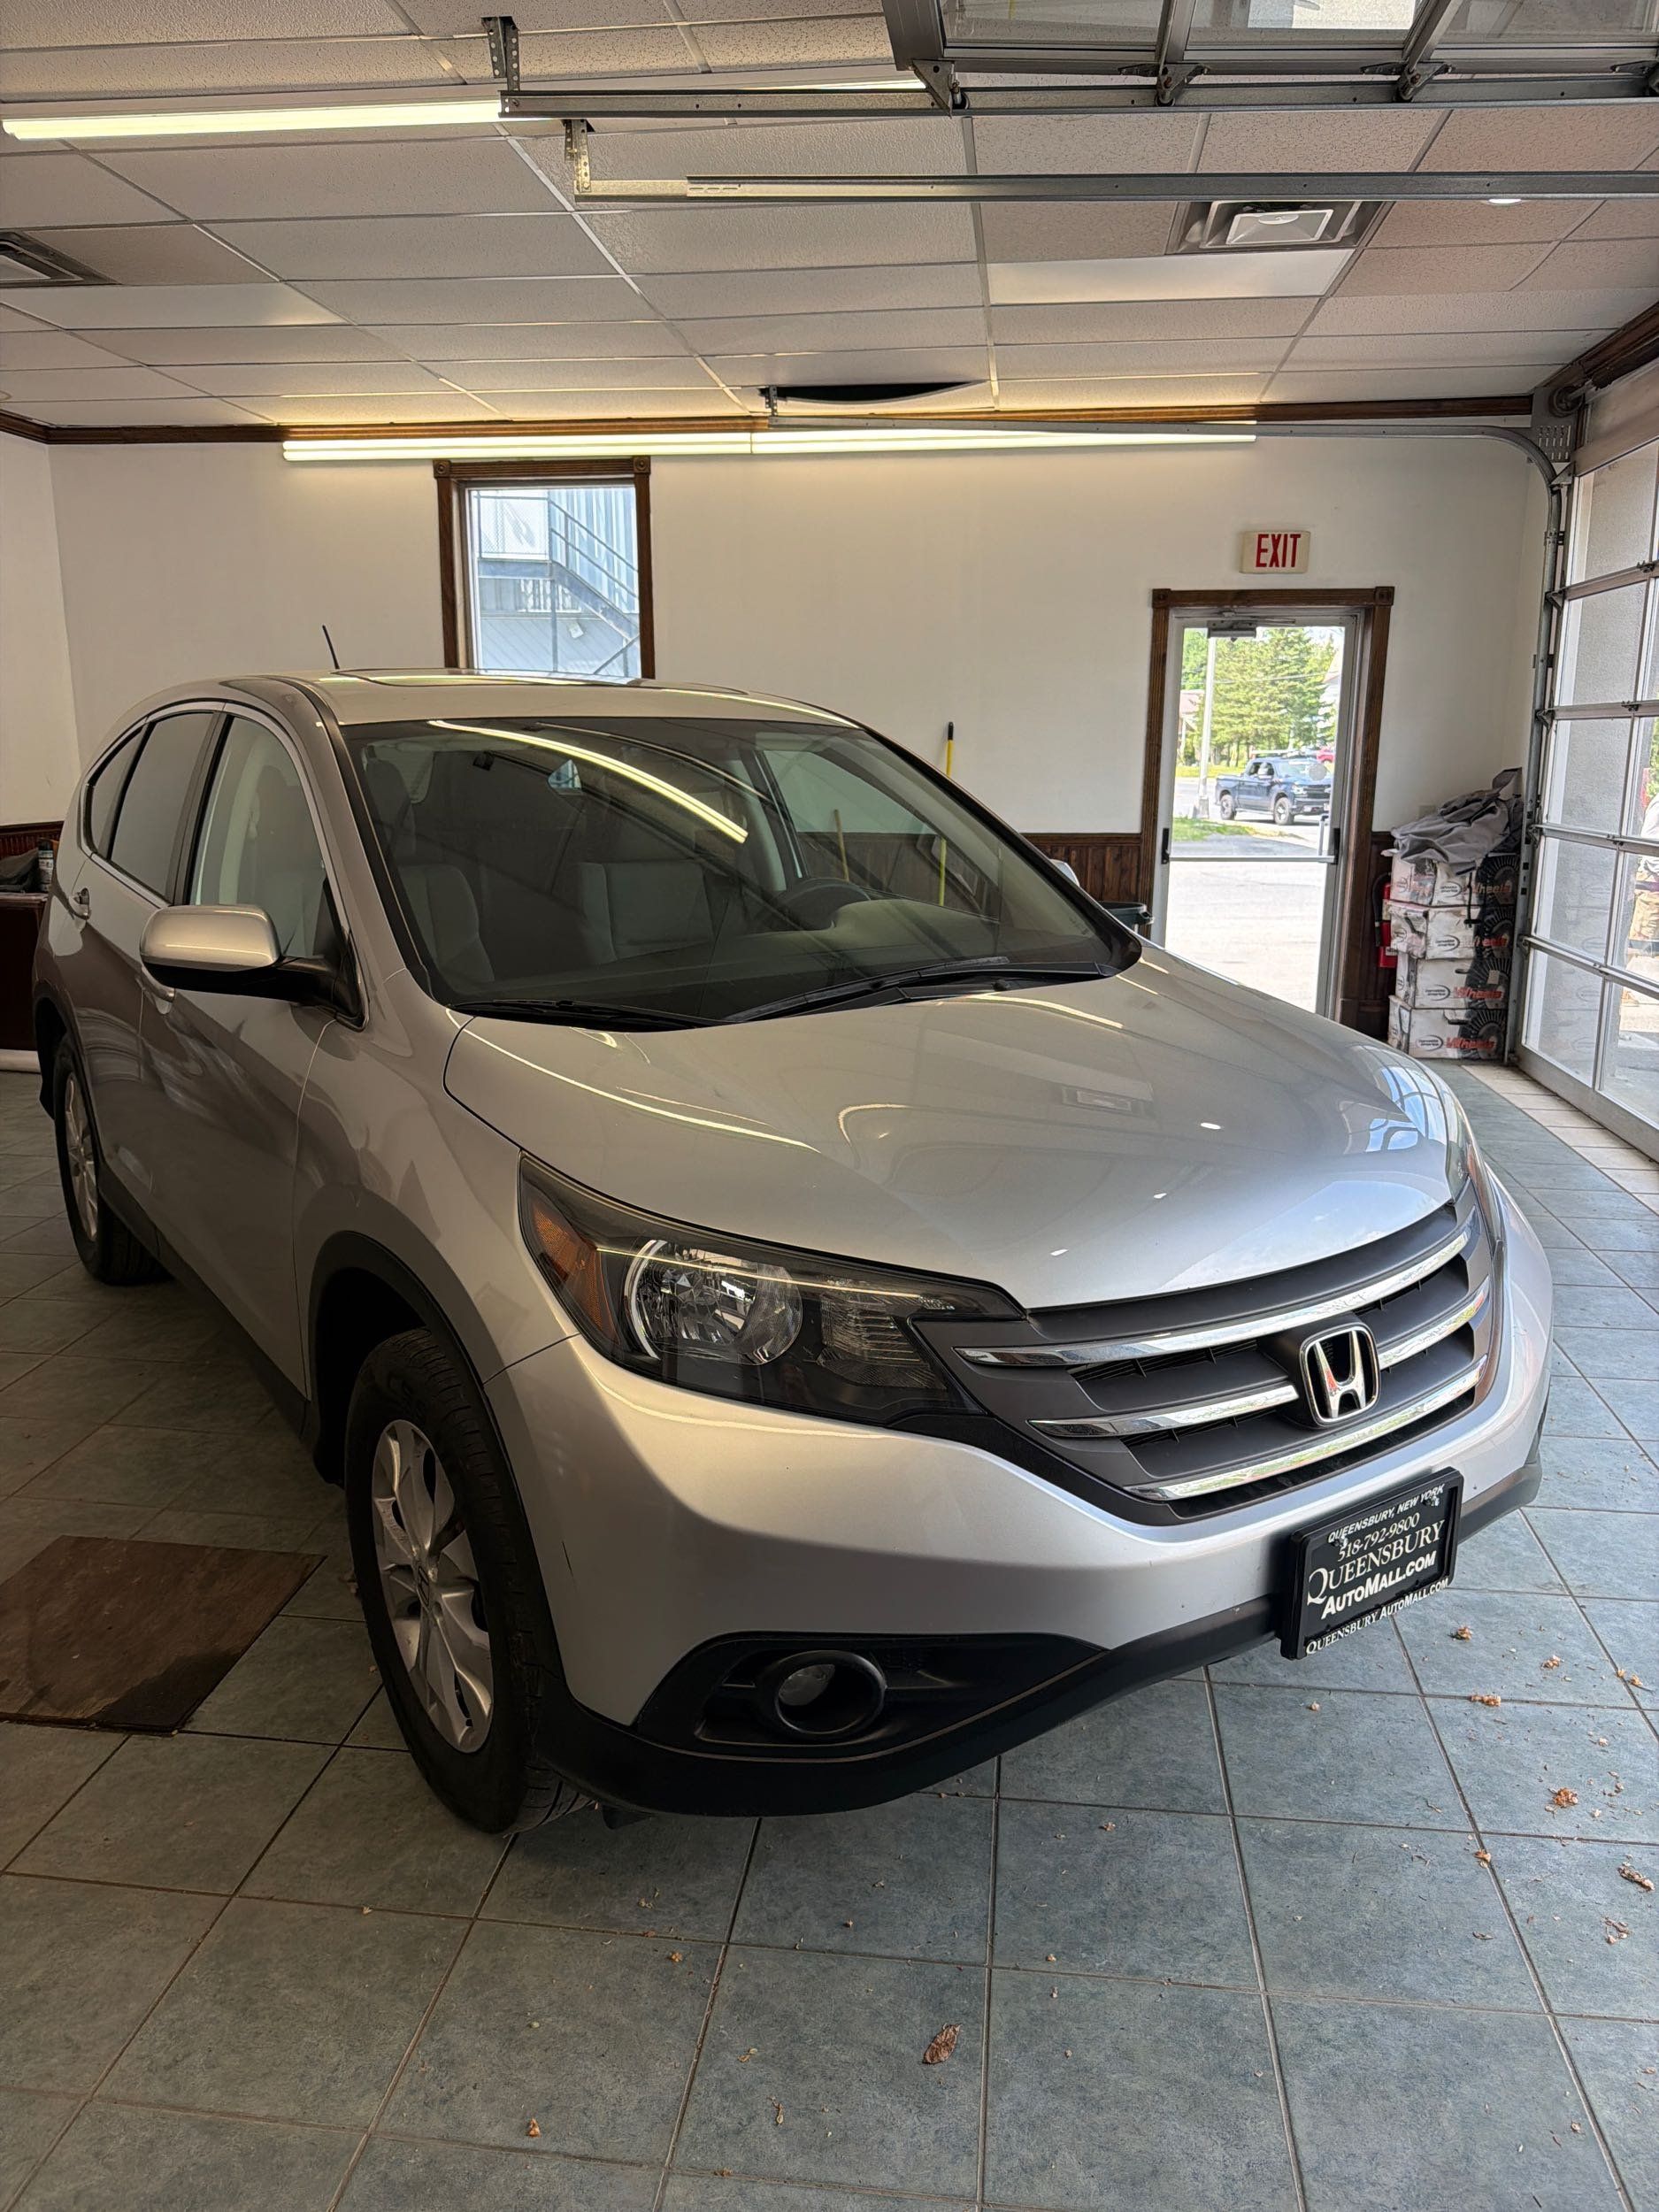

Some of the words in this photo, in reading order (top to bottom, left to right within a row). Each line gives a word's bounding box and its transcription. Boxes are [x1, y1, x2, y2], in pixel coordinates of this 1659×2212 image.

[1256, 534, 1302, 568] EXIT
[1327, 1506, 1395, 1543] QUEENSBURY,
[1397, 1496, 1419, 1514] NEW
[1420, 1484, 1446, 1500] YORK
[1337, 1512, 1420, 1562] 518-792-9800
[1307, 1520, 1446, 1606] QUEENSBURY
